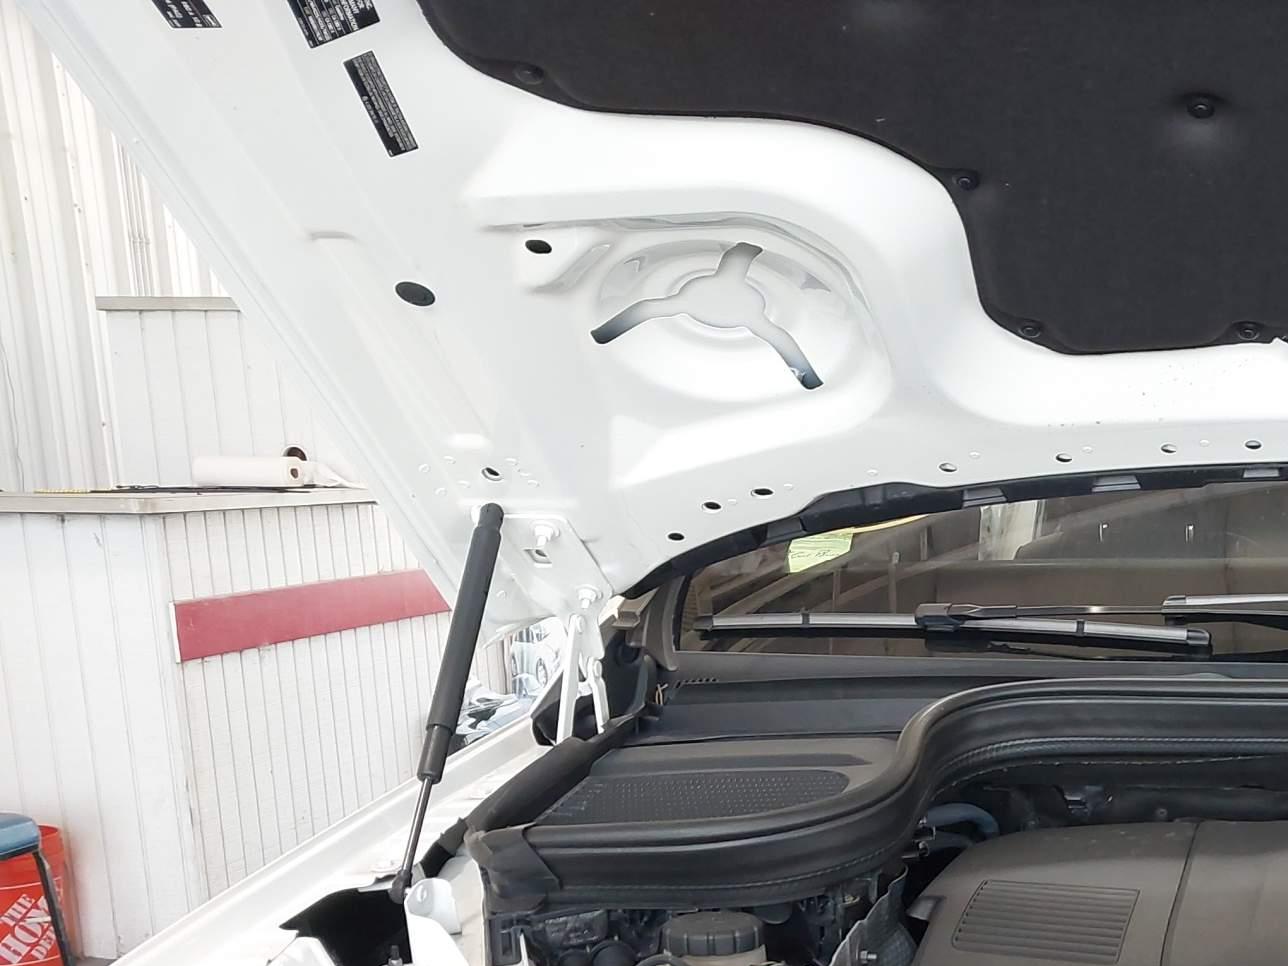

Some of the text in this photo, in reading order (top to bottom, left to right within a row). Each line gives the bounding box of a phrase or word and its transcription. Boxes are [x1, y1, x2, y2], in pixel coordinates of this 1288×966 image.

[0, 893, 36, 928] THE
[0, 895, 52, 966] HOM
[31, 924, 57, 961] DEP
